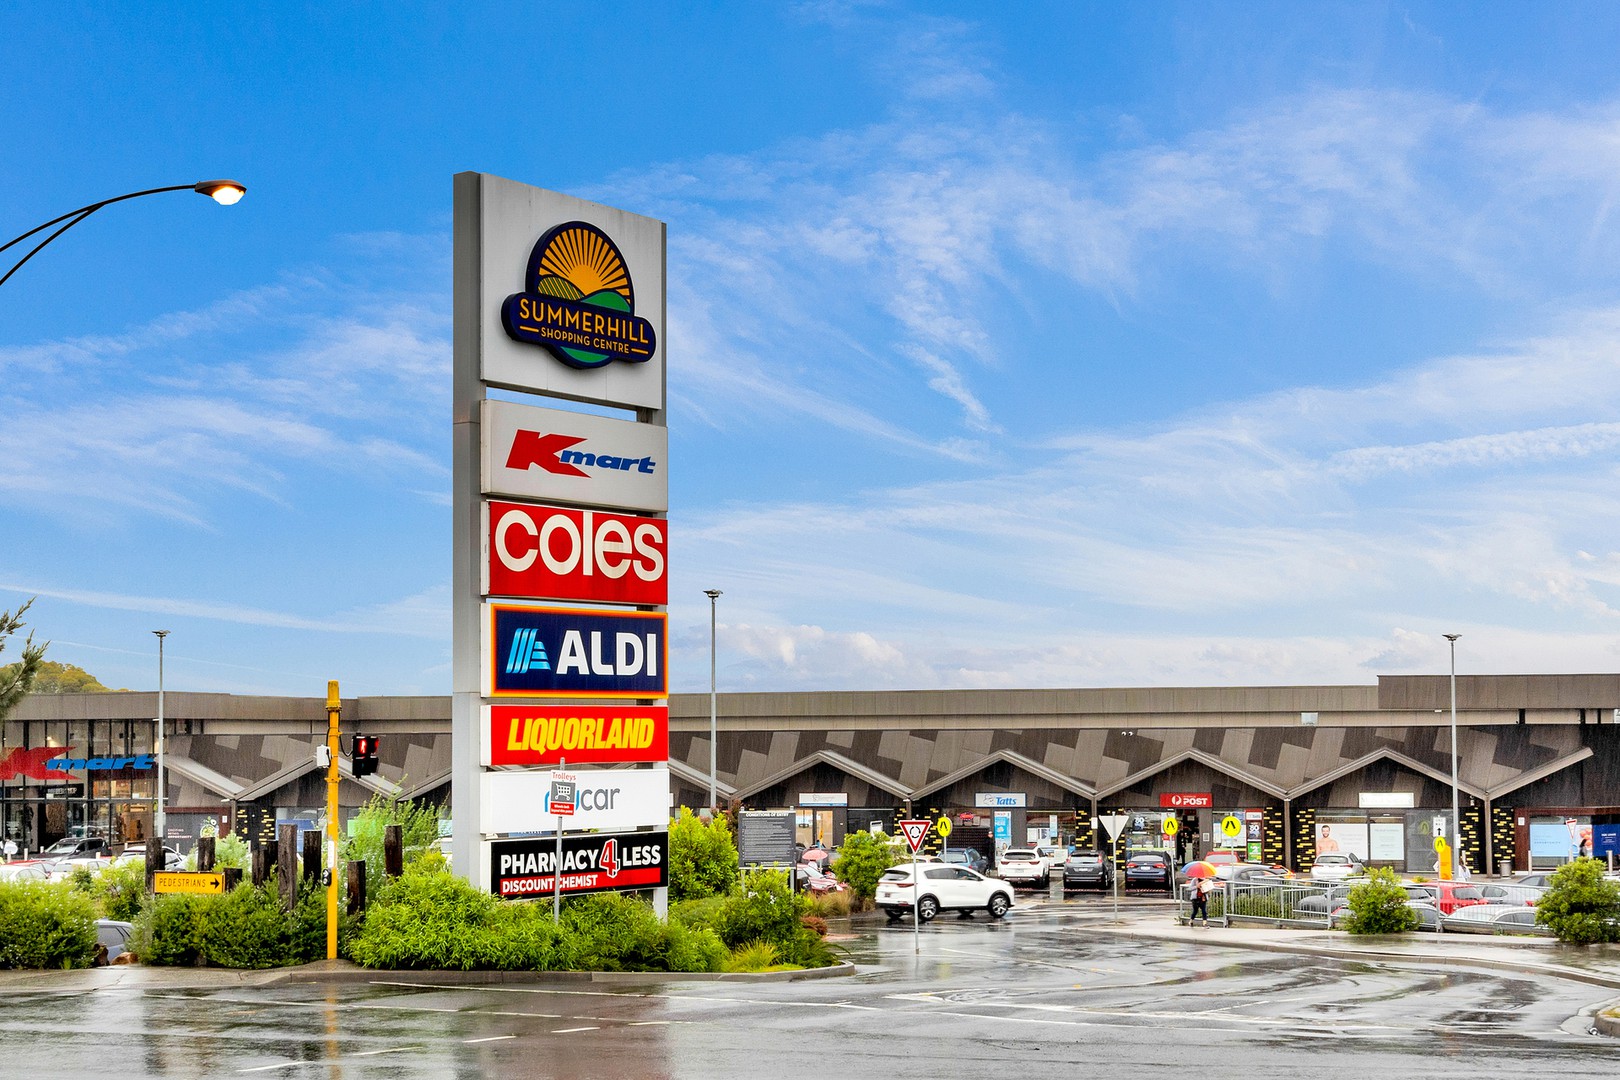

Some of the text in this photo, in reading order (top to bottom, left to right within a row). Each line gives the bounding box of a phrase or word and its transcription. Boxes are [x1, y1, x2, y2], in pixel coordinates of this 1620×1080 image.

[519, 298, 649, 344] SUMMERHILL
[540, 326, 630, 354] SHOPPING CENTRE
[505, 428, 656, 479] Kmart
[495, 510, 664, 582] coles
[556, 630, 657, 677] ALDI
[507, 717, 655, 755] LIQUORLAND
[0, 746, 155, 781] Kmart
[552, 771, 576, 782] Trolleys
[996, 796, 1017, 806] Tatts
[1183, 797, 1208, 806] POST
[500, 838, 661, 879] PHARMACY 4 LESS
[159, 877, 206, 888] PEDESTRIANS
[502, 877, 555, 893] DISCOUNT
